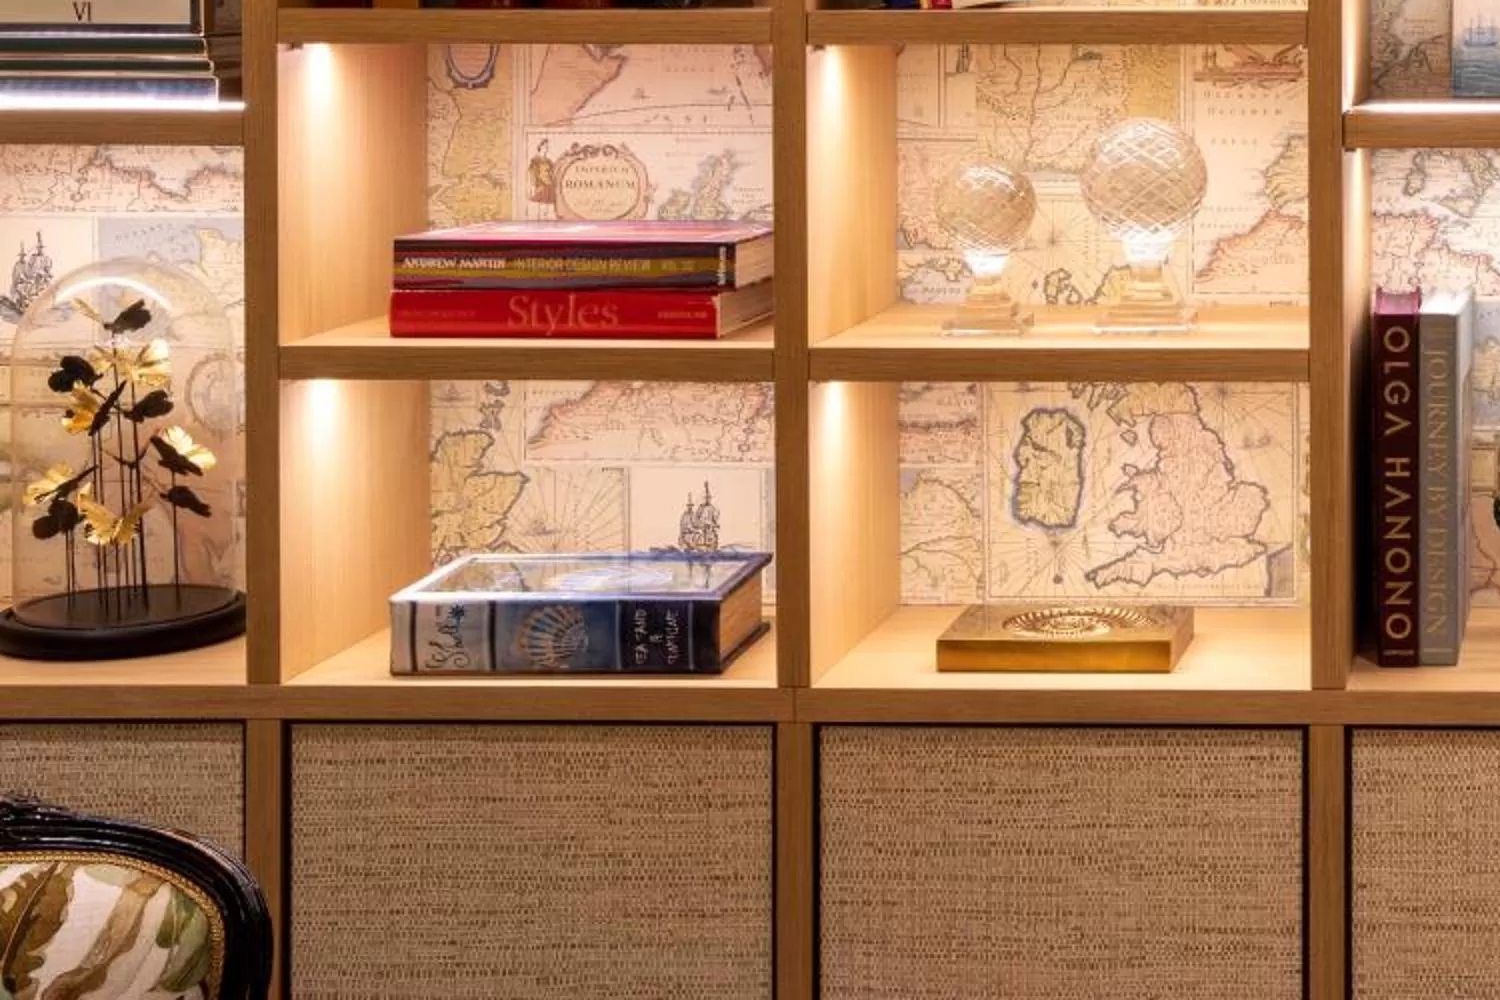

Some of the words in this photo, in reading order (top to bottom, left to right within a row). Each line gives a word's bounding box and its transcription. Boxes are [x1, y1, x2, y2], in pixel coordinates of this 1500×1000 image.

[72, 1, 93, 22] VI
[506, 293, 621, 337] Styles
[1382, 326, 1412, 437] OLGA
[1384, 456, 1414, 641] HANONO
